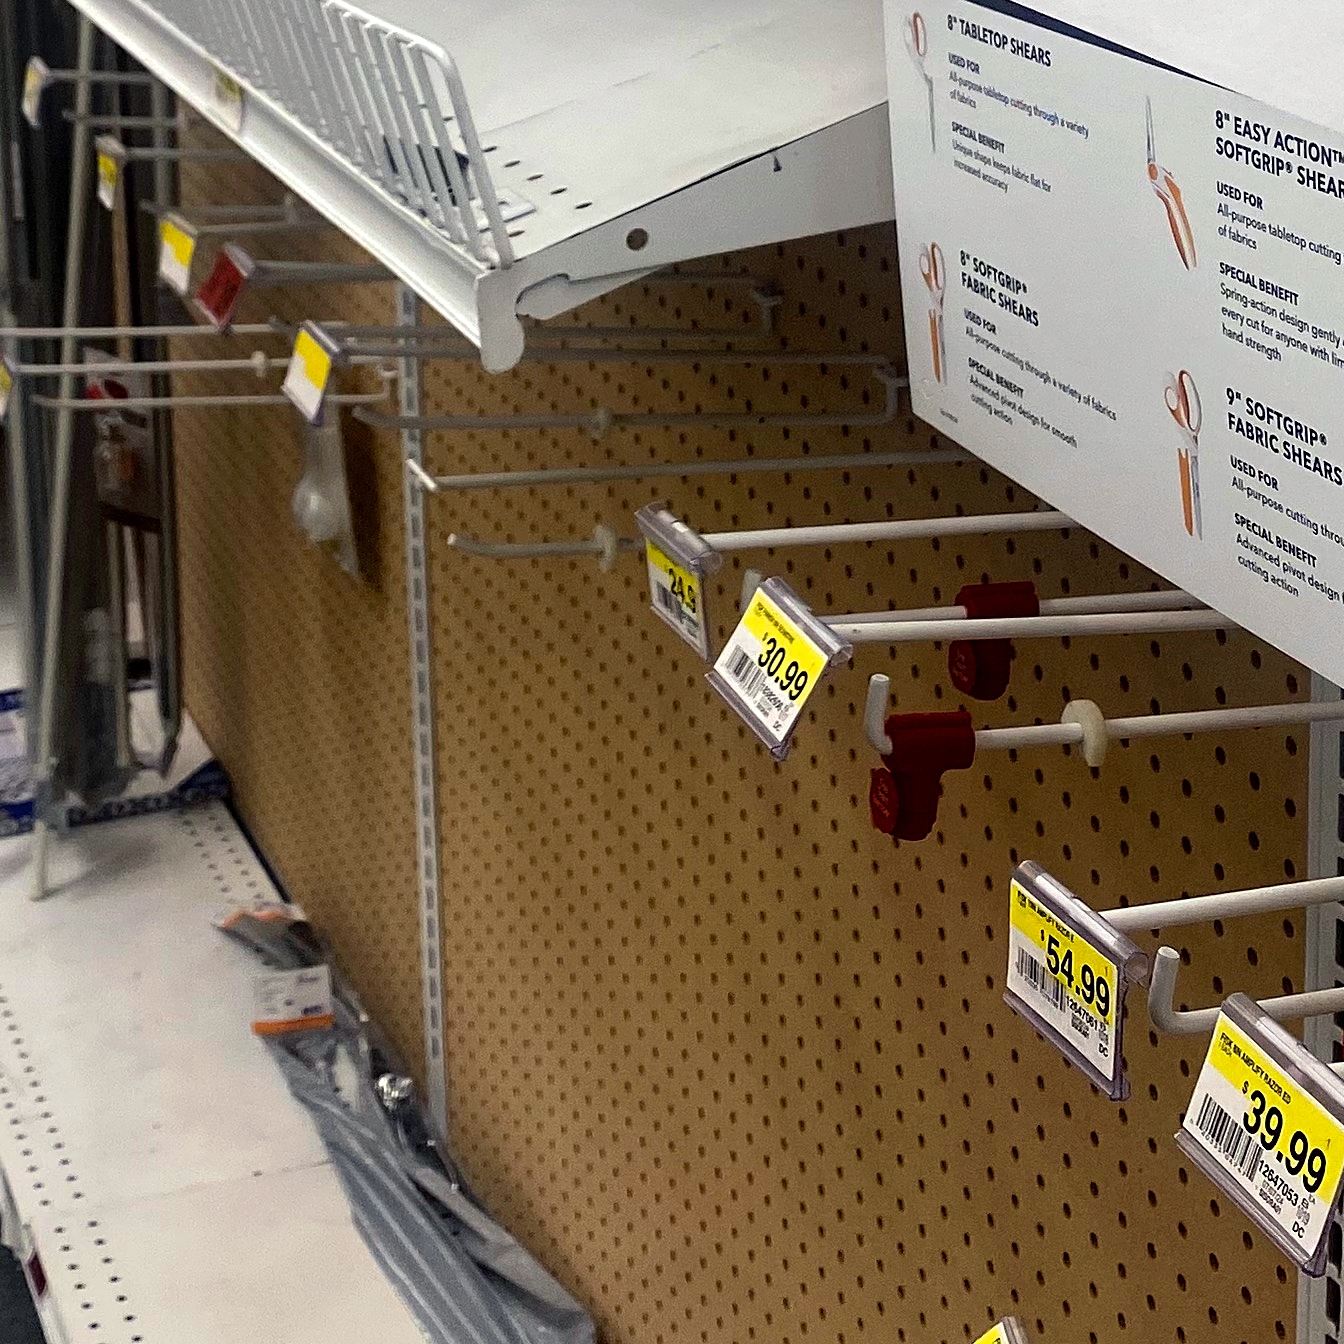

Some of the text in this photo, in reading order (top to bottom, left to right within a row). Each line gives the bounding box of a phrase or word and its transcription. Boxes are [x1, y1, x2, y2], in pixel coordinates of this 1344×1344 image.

[959, 19, 1008, 49] TABLETOP
[1011, 38, 1051, 67] SHEARS
[1234, 116, 1271, 145] EASY
[1217, 181, 1263, 210] USED FOR
[1217, 203, 1266, 232] All-purpose
[1268, 224, 1306, 250] tabletop
[1309, 242, 1341, 265] cutting
[1218, 226, 1257, 249] of fabrics
[962, 273, 1038, 326] FABRIC SHEARS
[1220, 262, 1298, 305] SPECIAL BENEFIT
[1221, 283, 1277, 317] Spring-action
[1279, 309, 1309, 333] design
[1312, 326, 1340, 348] gently
[1228, 412, 1342, 485] FABRIC SHEARS
[1230, 455, 1278, 491] USED FOR
[1235, 513, 1316, 568] SPECIAL BENEFIT
[1259, 1159, 1299, 1207] 12647053
[1292, 1220, 1305, 1238] DC
